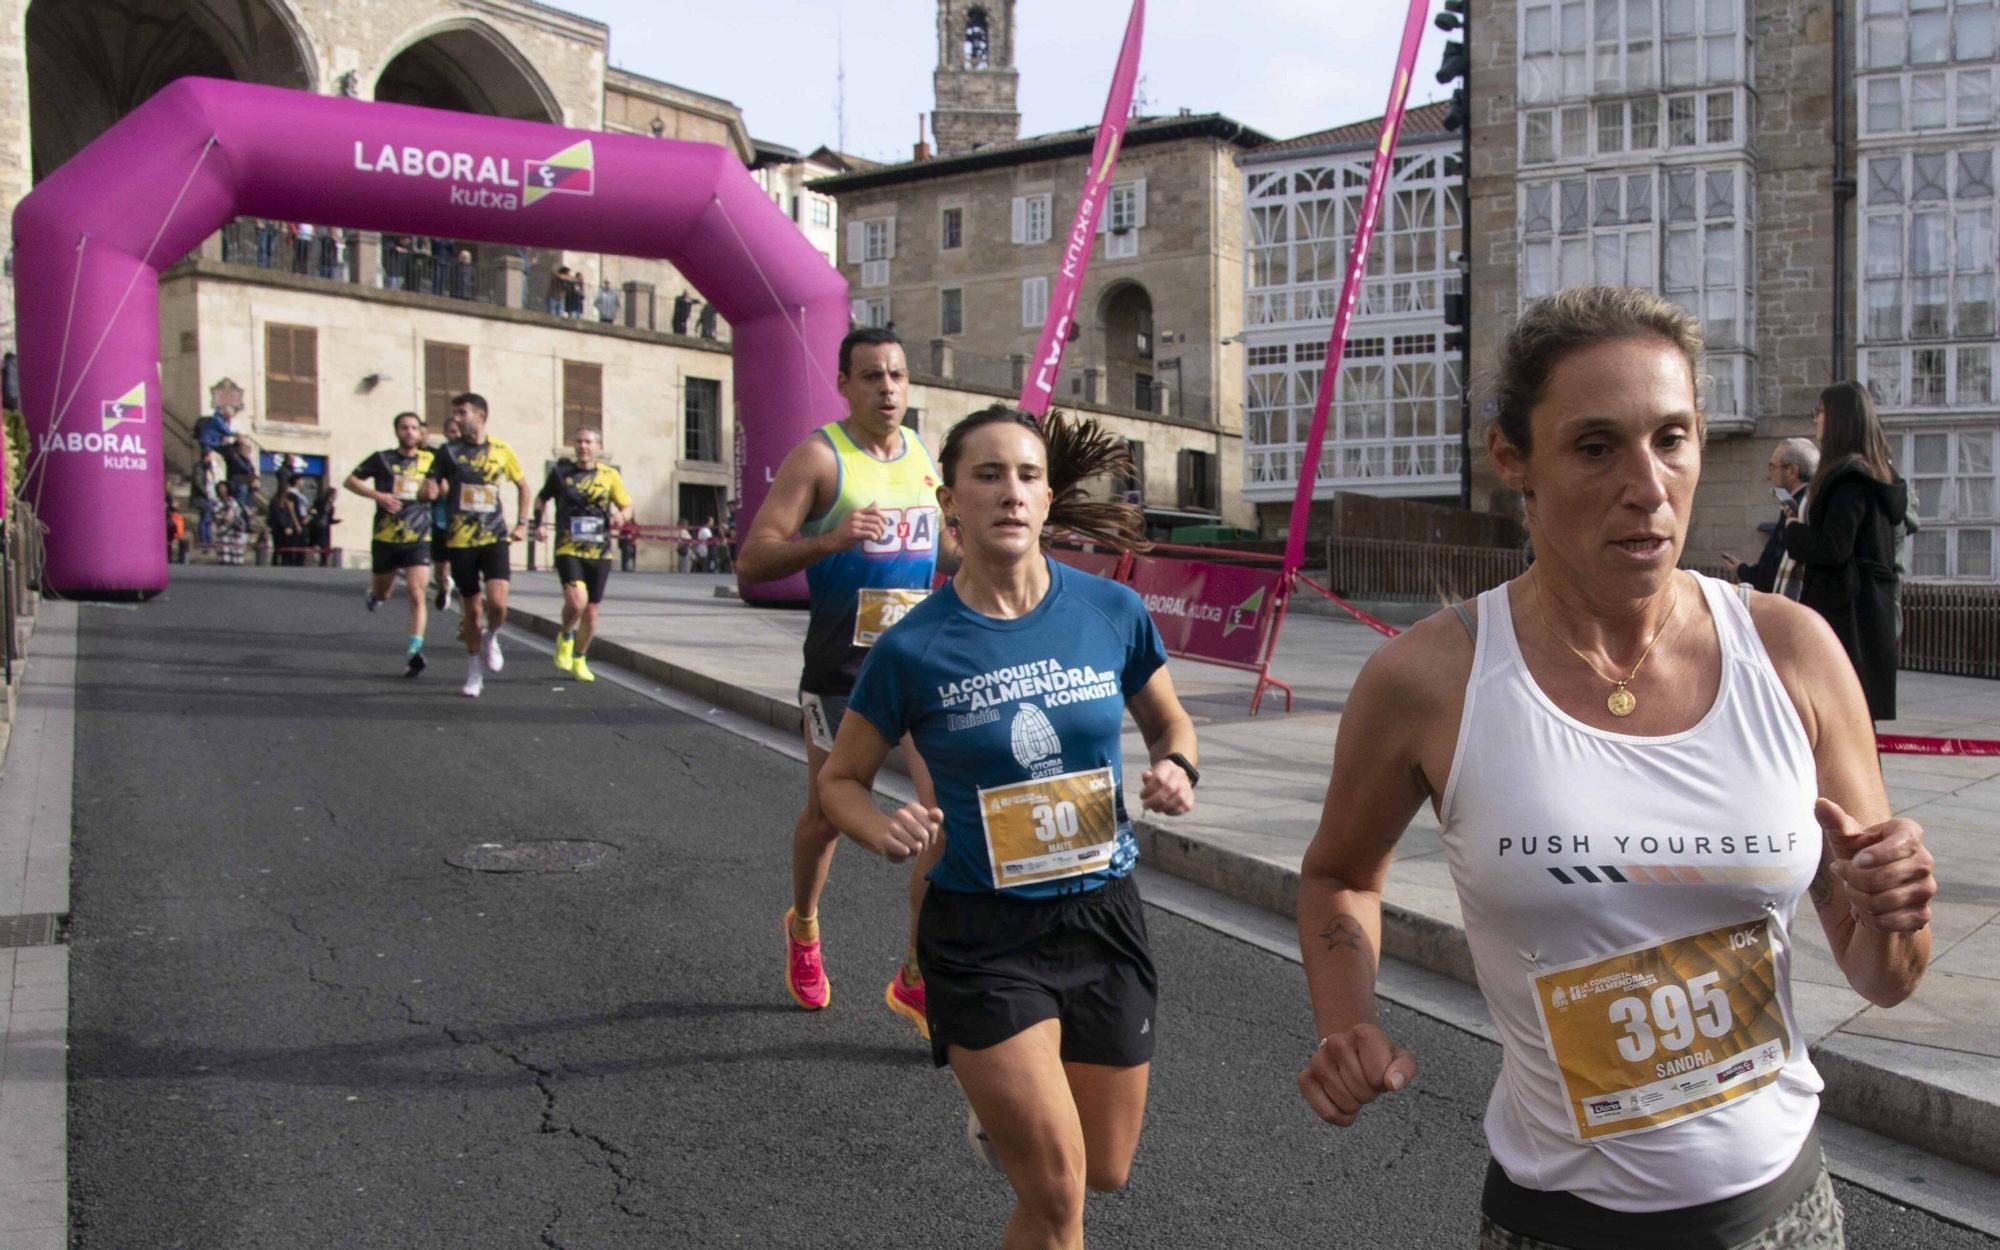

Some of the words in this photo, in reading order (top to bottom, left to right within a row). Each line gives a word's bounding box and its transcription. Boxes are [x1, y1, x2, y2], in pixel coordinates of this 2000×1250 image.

[354, 141, 519, 187] LABORAL
[451, 185, 518, 211] kutxa
[39, 432, 147, 455] LABORAL
[104, 454, 147, 471] kutxa
[1144, 593, 1187, 617] ABORAL
[1187, 601, 1222, 622] kutxa
[938, 682, 960, 698] LA
[960, 658, 1063, 693] CONQUISTA
[942, 699, 956, 708] DE
[956, 694, 970, 704] LA
[970, 665, 1100, 711] ALMENDRA
[1044, 681, 1118, 708] KONKISTA
[1029, 758, 1064, 772] VITORIA
[1031, 766, 1065, 780] GASTEIZ
[1032, 800, 1079, 842] 30
[1500, 834, 1590, 857] PUSH
[1613, 832, 1797, 855] YOURSELF
[1729, 930, 1759, 951] 10K
[1608, 971, 1734, 1062] 395
[1655, 1049, 1715, 1078] SANDRA
